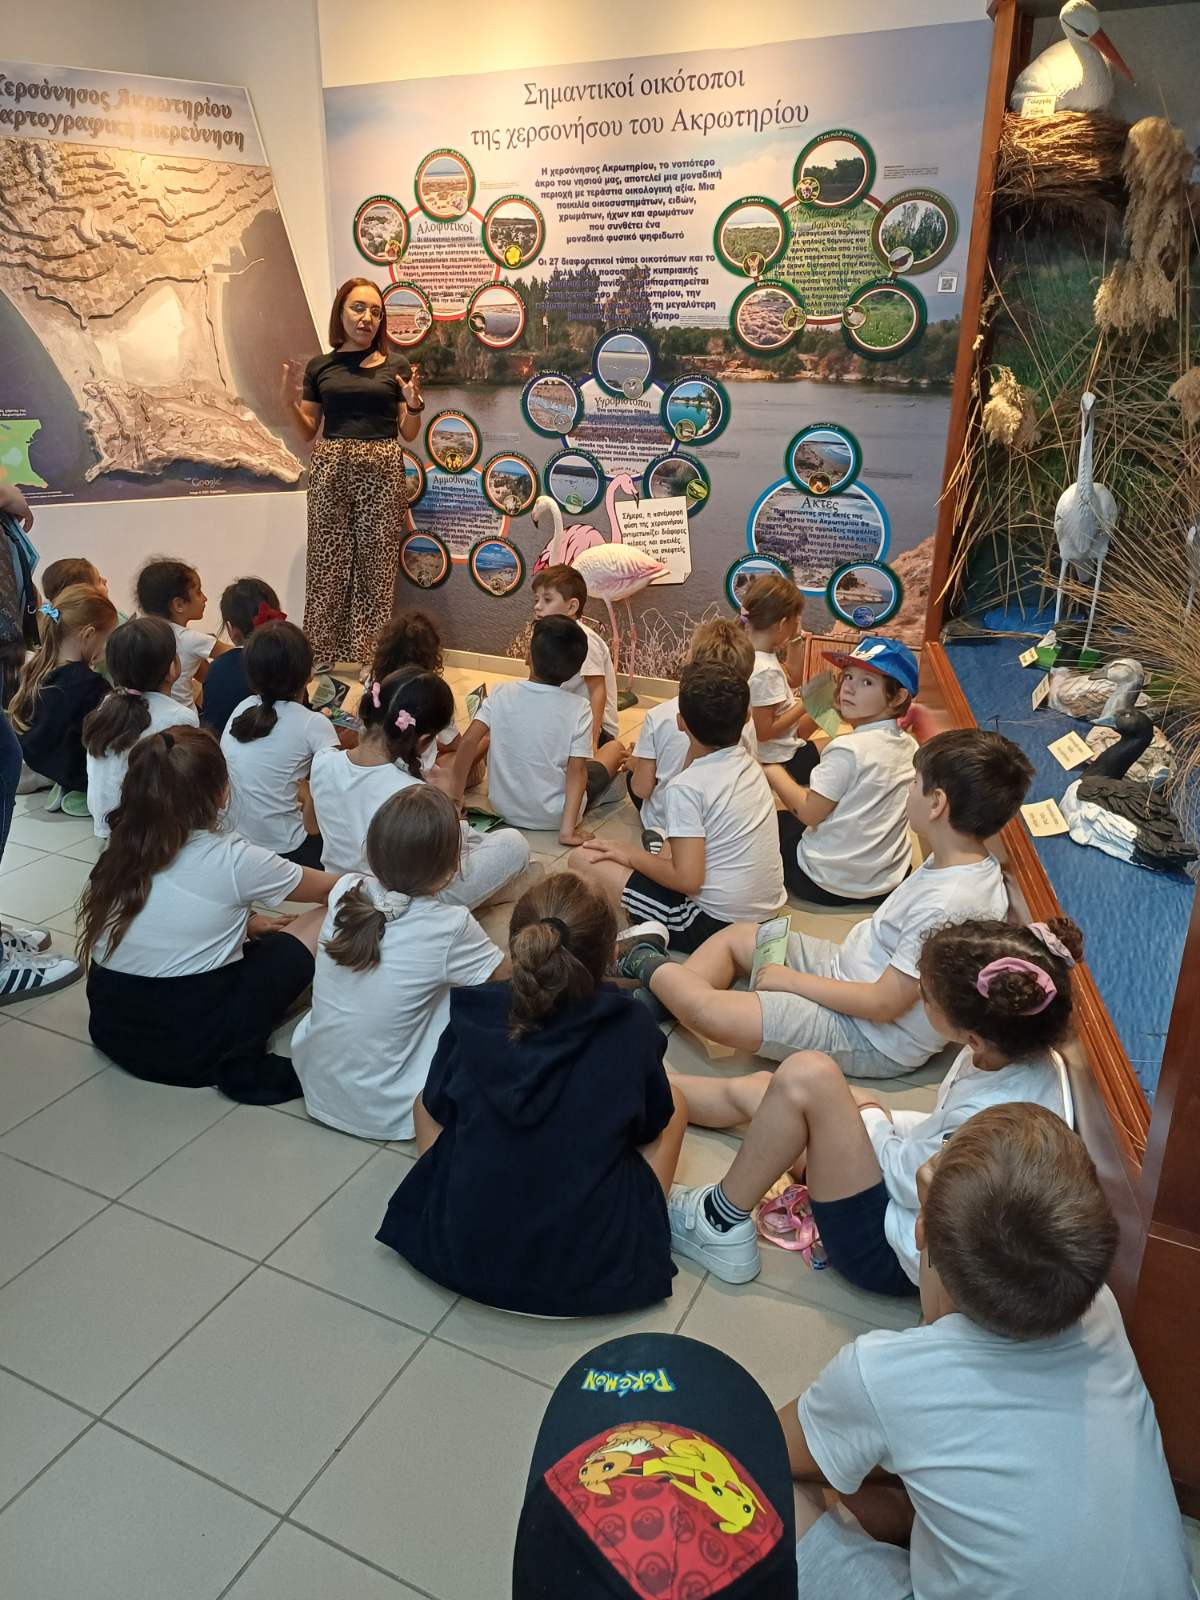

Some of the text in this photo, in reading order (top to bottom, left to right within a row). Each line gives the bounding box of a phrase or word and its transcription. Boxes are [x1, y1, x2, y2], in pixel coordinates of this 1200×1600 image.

[524, 69, 746, 110] Σημαντικοί οικότοποι
[0, 108, 135, 140] αρτογραφική
[471, 100, 809, 150] της χερσονήσου του Ακρωτηρίου
[550, 166, 600, 177] χερσόνησος
[602, 162, 657, 173] Ακρωτηρίου,
[672, 159, 715, 169] νοτιότερο
[535, 179, 555, 188] άκρο
[574, 177, 602, 186] νησιού
[605, 178, 621, 186] μας,
[625, 174, 661, 184] αποτελεί
[664, 174, 678, 183] μια
[681, 170, 721, 181] μοναδική
[541, 189, 572, 199] περιοχή
[587, 187, 623, 197] τεράστια
[625, 184, 672, 195] οικολογική
[675, 183, 696, 194] αξία.
[699, 182, 715, 191] Μια
[557, 196, 696, 210] ποικιλία οικοσυστημάτων, ειδών,
[559, 210, 604, 222] χρωμάτων,
[607, 210, 629, 220] ήχων
[648, 208, 693, 218] αρωμάτων
[417, 221, 473, 235] Αλοφυτικοί
[607, 222, 643, 230] συνθέτει
[567, 231, 684, 244] μοναδικό φυσικό ψηφιδωτό
[561, 255, 613, 266] διαφορετικοί
[616, 255, 637, 265] τύποι
[641, 255, 687, 264] οικοτόπων
[653, 266, 698, 276] κυπριακής
[651, 277, 709, 286] παρατηρείται
[666, 301, 715, 310] μεγαλύτερη
[192, 476, 221, 489] Google
[801, 497, 840, 512] Ακτές
[622, 512, 644, 520] Σήμερα,
[651, 519, 683, 528] χερσονήσου
